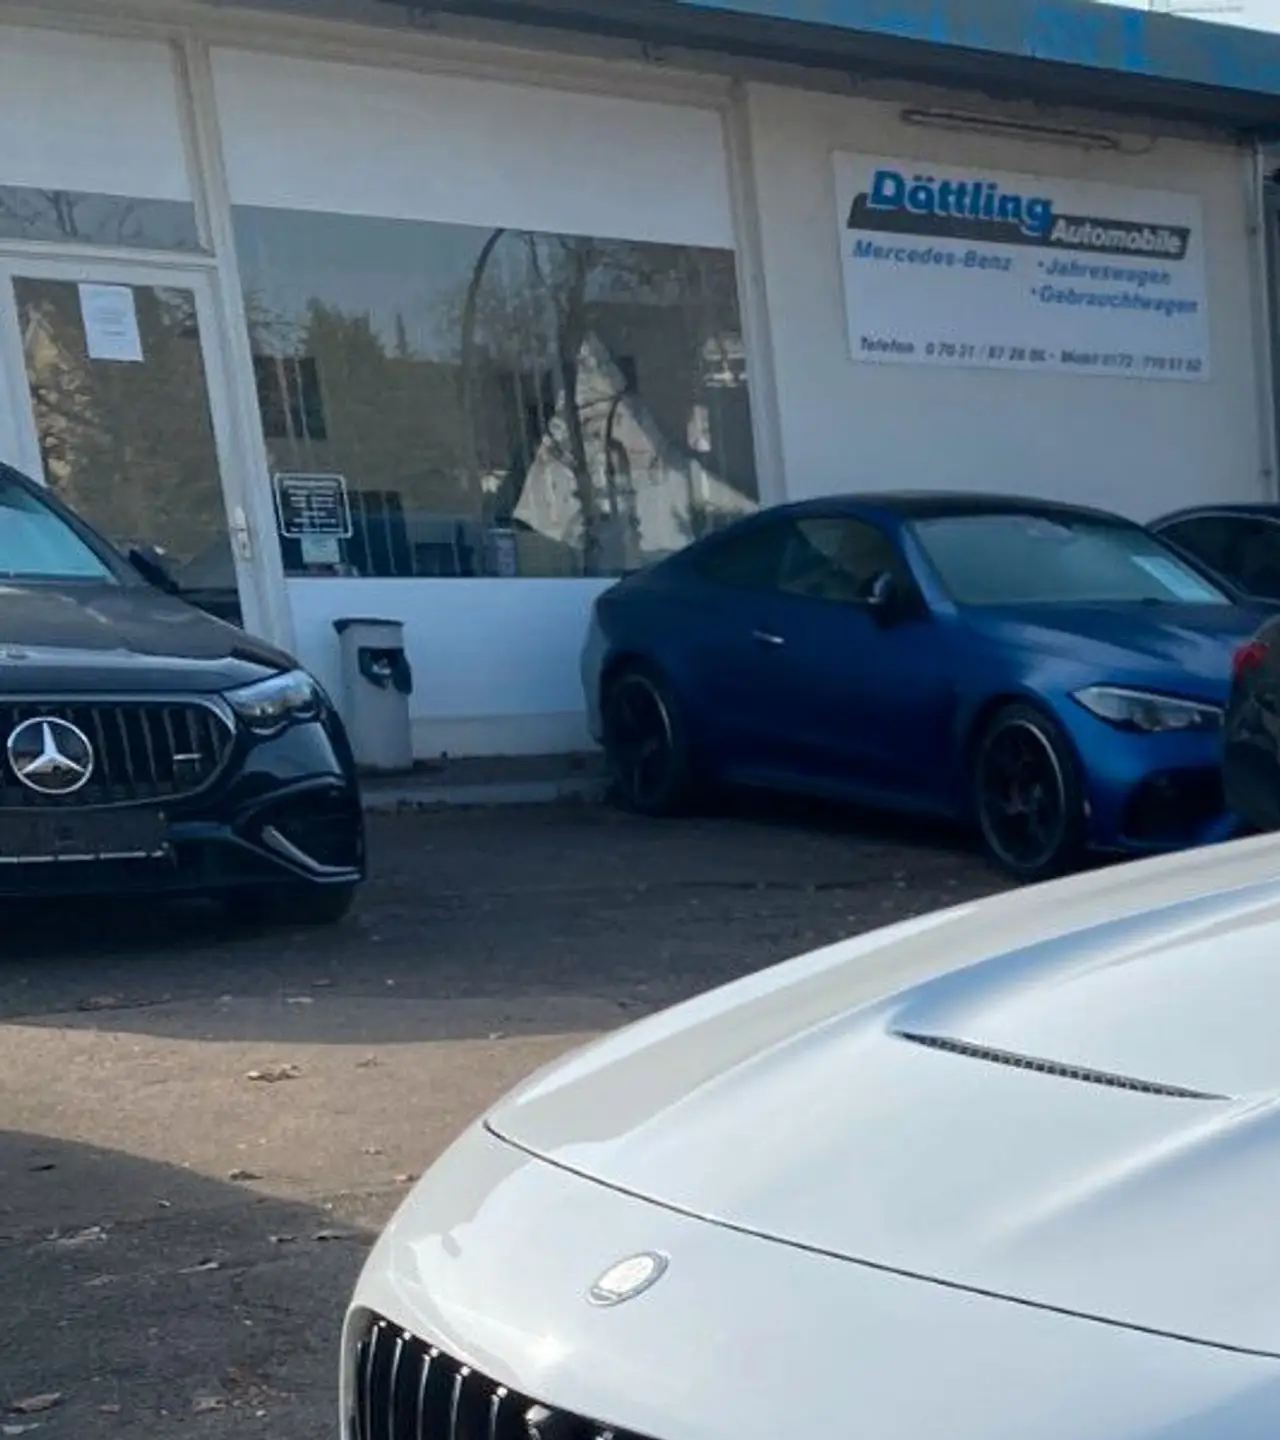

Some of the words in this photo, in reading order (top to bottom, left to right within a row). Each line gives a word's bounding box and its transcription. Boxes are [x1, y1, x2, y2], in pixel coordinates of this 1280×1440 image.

[870, 170, 1052, 234] Döttling
[1050, 218, 1182, 254] Automobile
[853, 239, 1012, 271] Mercedes-Benz
[1046, 257, 1171, 287] Jahreswagen
[860, 335, 914, 353] Telefon
